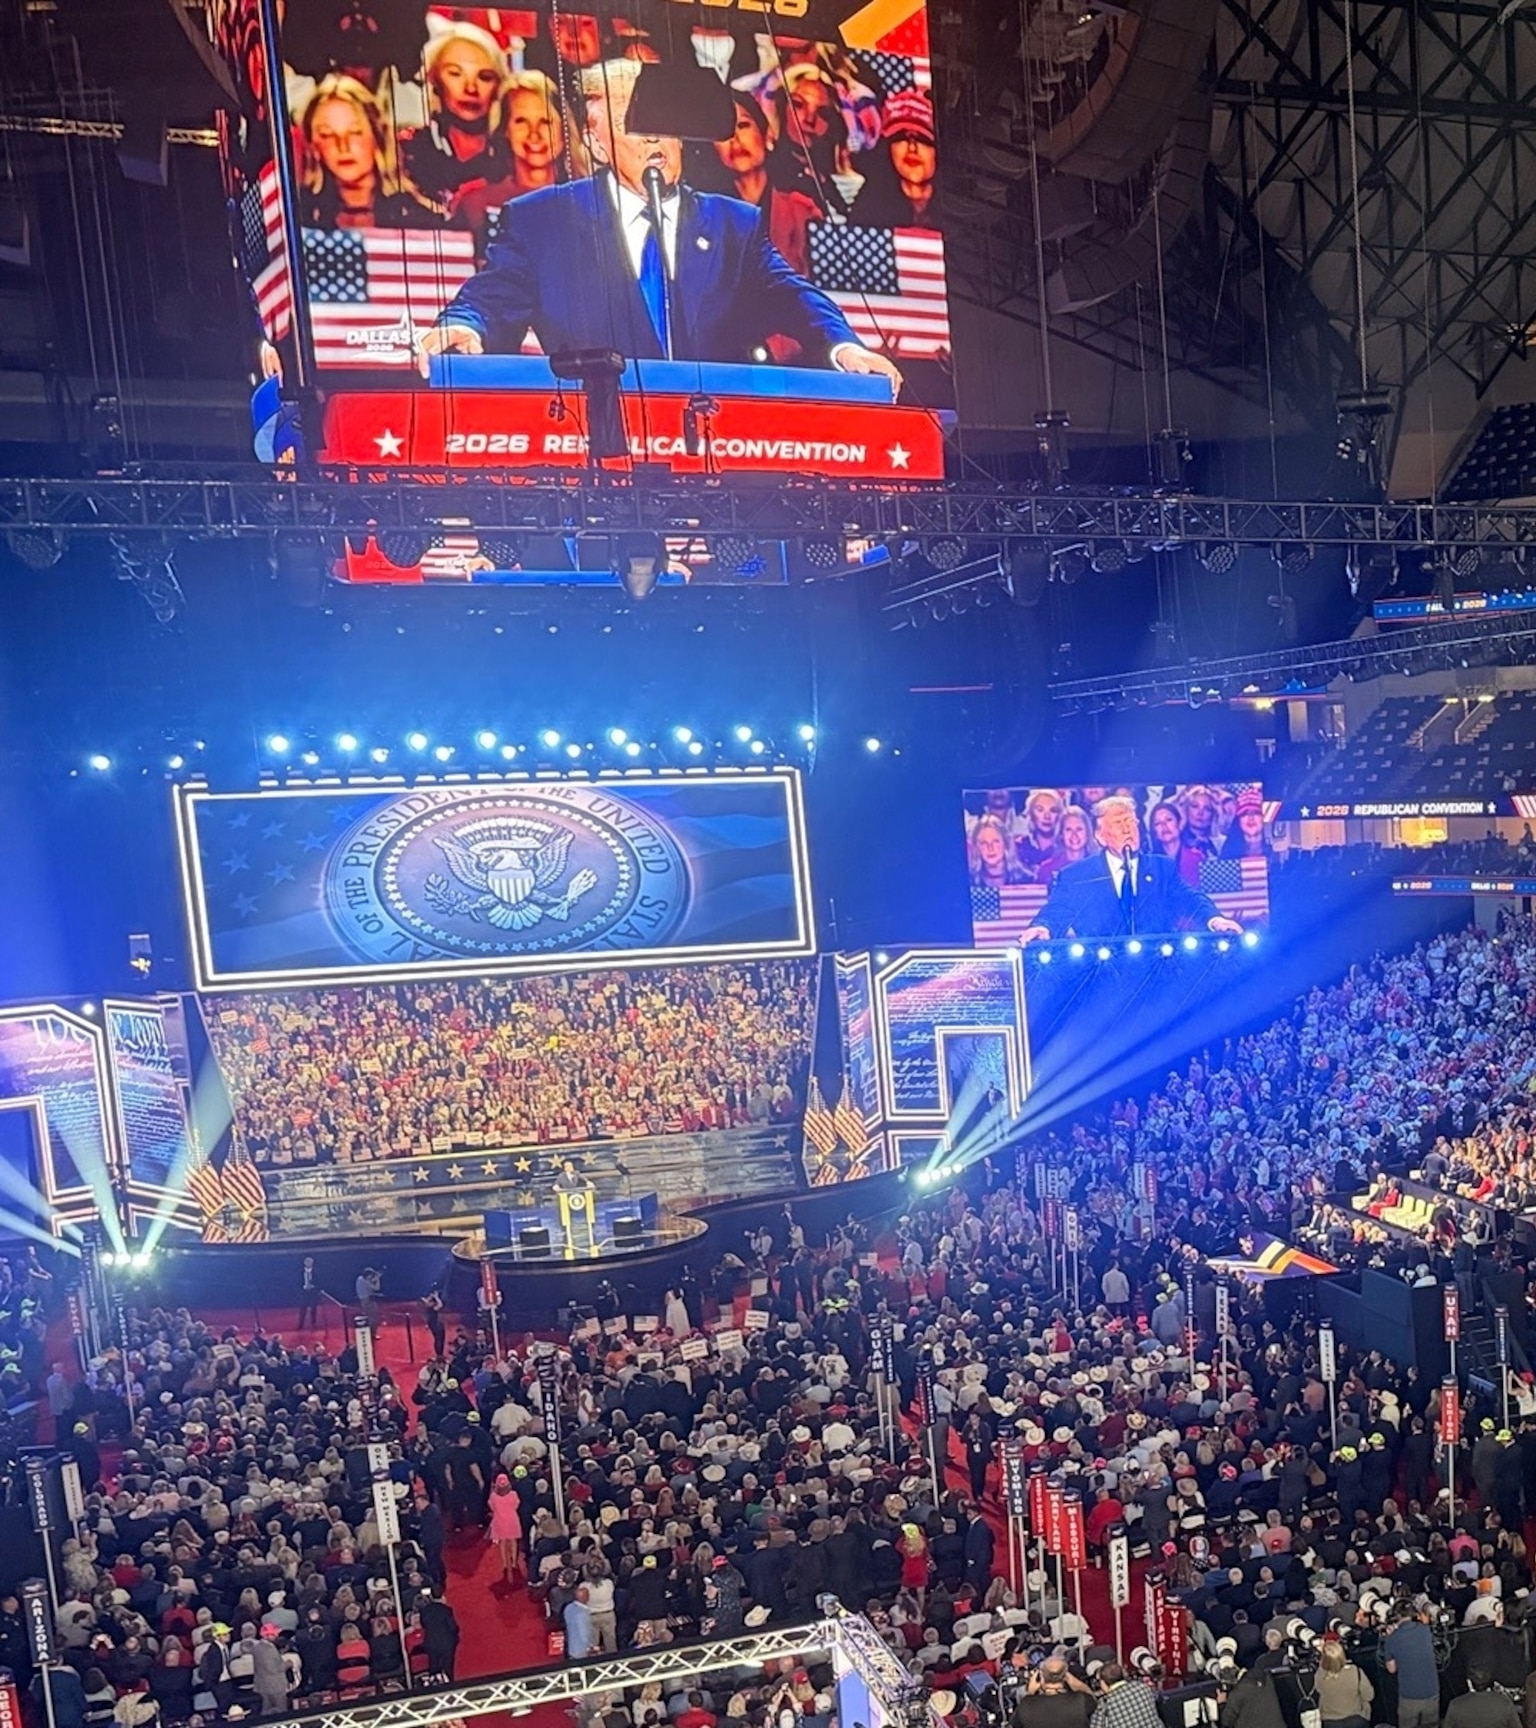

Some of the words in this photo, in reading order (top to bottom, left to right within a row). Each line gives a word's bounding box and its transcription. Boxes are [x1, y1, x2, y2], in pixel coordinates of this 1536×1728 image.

[346, 330, 411, 345] DALLAS
[446, 434, 529, 453] 2026
[710, 438, 866, 462] CONVENTION
[1316, 805, 1349, 816] 2026
[1354, 804, 1419, 816] REPUBLICAN
[1421, 802, 1484, 815] CONVENTION
[587, 797, 671, 874] UNITED
[344, 877, 368, 910] THE
[354, 913, 384, 934] OF
[68, 1296, 81, 1335] NEVADA
[1446, 1297, 1456, 1336] UTAH
[870, 1329, 883, 1370] GUAM
[545, 1391, 557, 1440] IDAHO
[1445, 1391, 1454, 1440] MICHIGAN
[32, 1473, 48, 1527] COLORADO
[380, 1485, 388, 1502] NEW
[1009, 1459, 1023, 1513] WYOMING
[382, 1507, 393, 1540] MEXICO
[1051, 1493, 1060, 1550] MARYLAND
[1067, 1507, 1079, 1566] MISSOURI
[1115, 1543, 1124, 1601] KANSAS
[31, 1598, 49, 1661] ARIZONA
[1156, 1589, 1166, 1651] INDIANA
[1171, 1611, 1182, 1675] VIRGINIA
